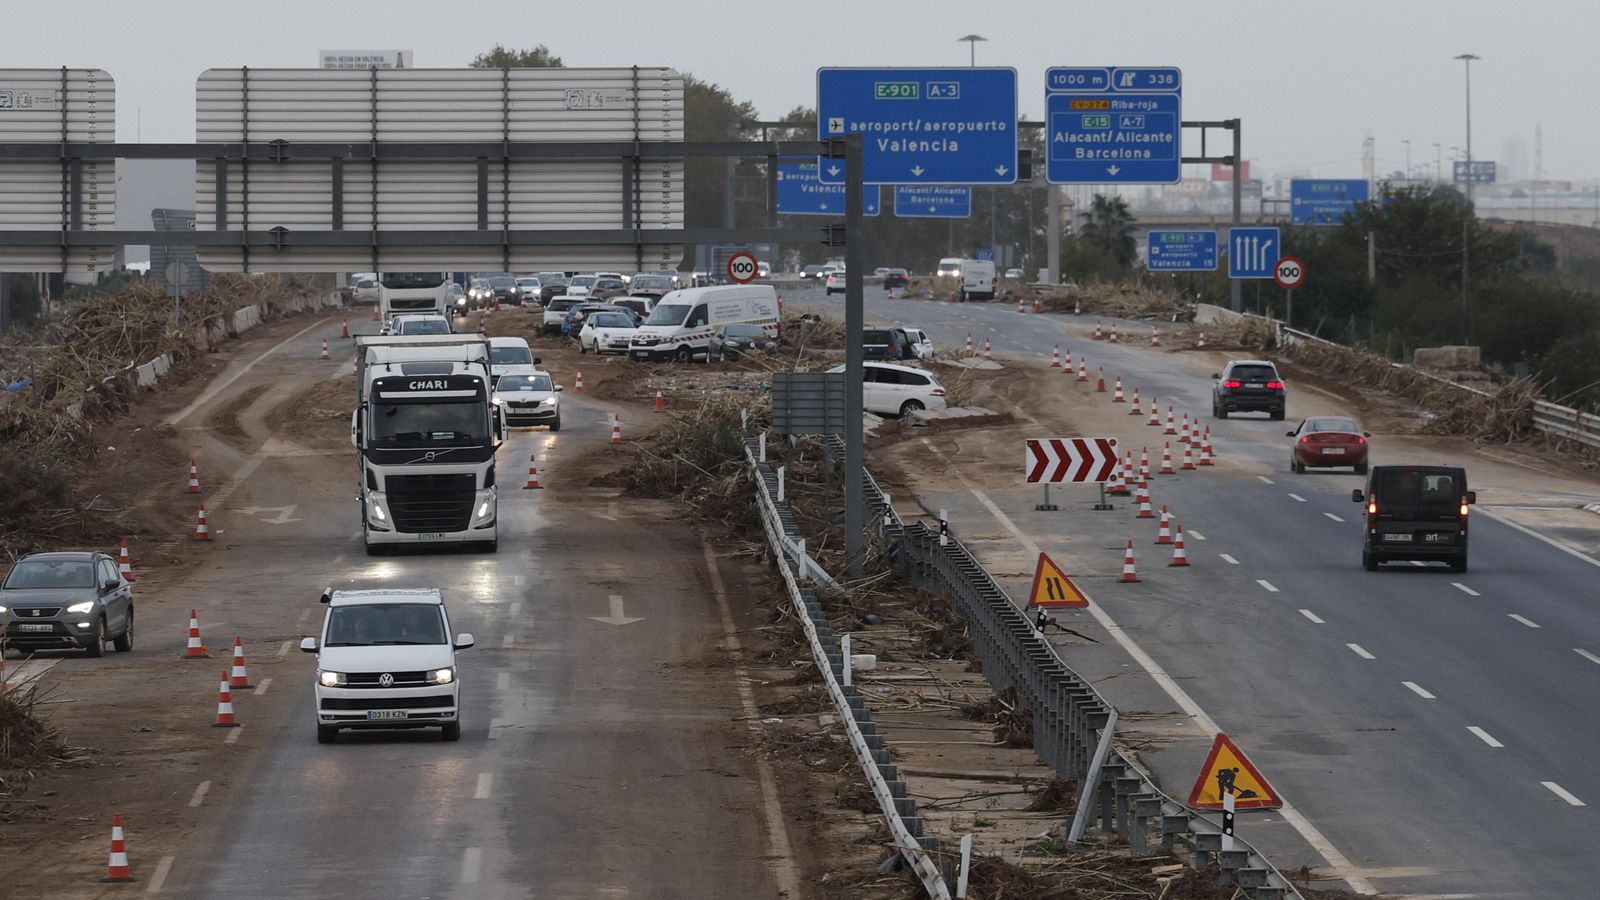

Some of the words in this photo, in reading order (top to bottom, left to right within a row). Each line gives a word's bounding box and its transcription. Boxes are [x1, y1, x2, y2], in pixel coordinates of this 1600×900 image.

[1053, 75, 1085, 84] 1000
[1092, 76, 1102, 84] m
[1149, 75, 1174, 84] 338
[877, 85, 917, 96] E-901
[930, 85, 957, 96] A-3
[1111, 100, 1158, 111] Riba-roja
[1085, 118, 1108, 127] E-15
[1122, 118, 1142, 127] A-7
[1115, 131, 1173, 143] Alicante
[877, 138, 959, 151] Valencia
[1075, 148, 1151, 158] Barcelona
[732, 262, 753, 273] 100
[1279, 267, 1300, 278] 100
[409, 380, 448, 390] CHARI
[372, 711, 390, 719] 0318
